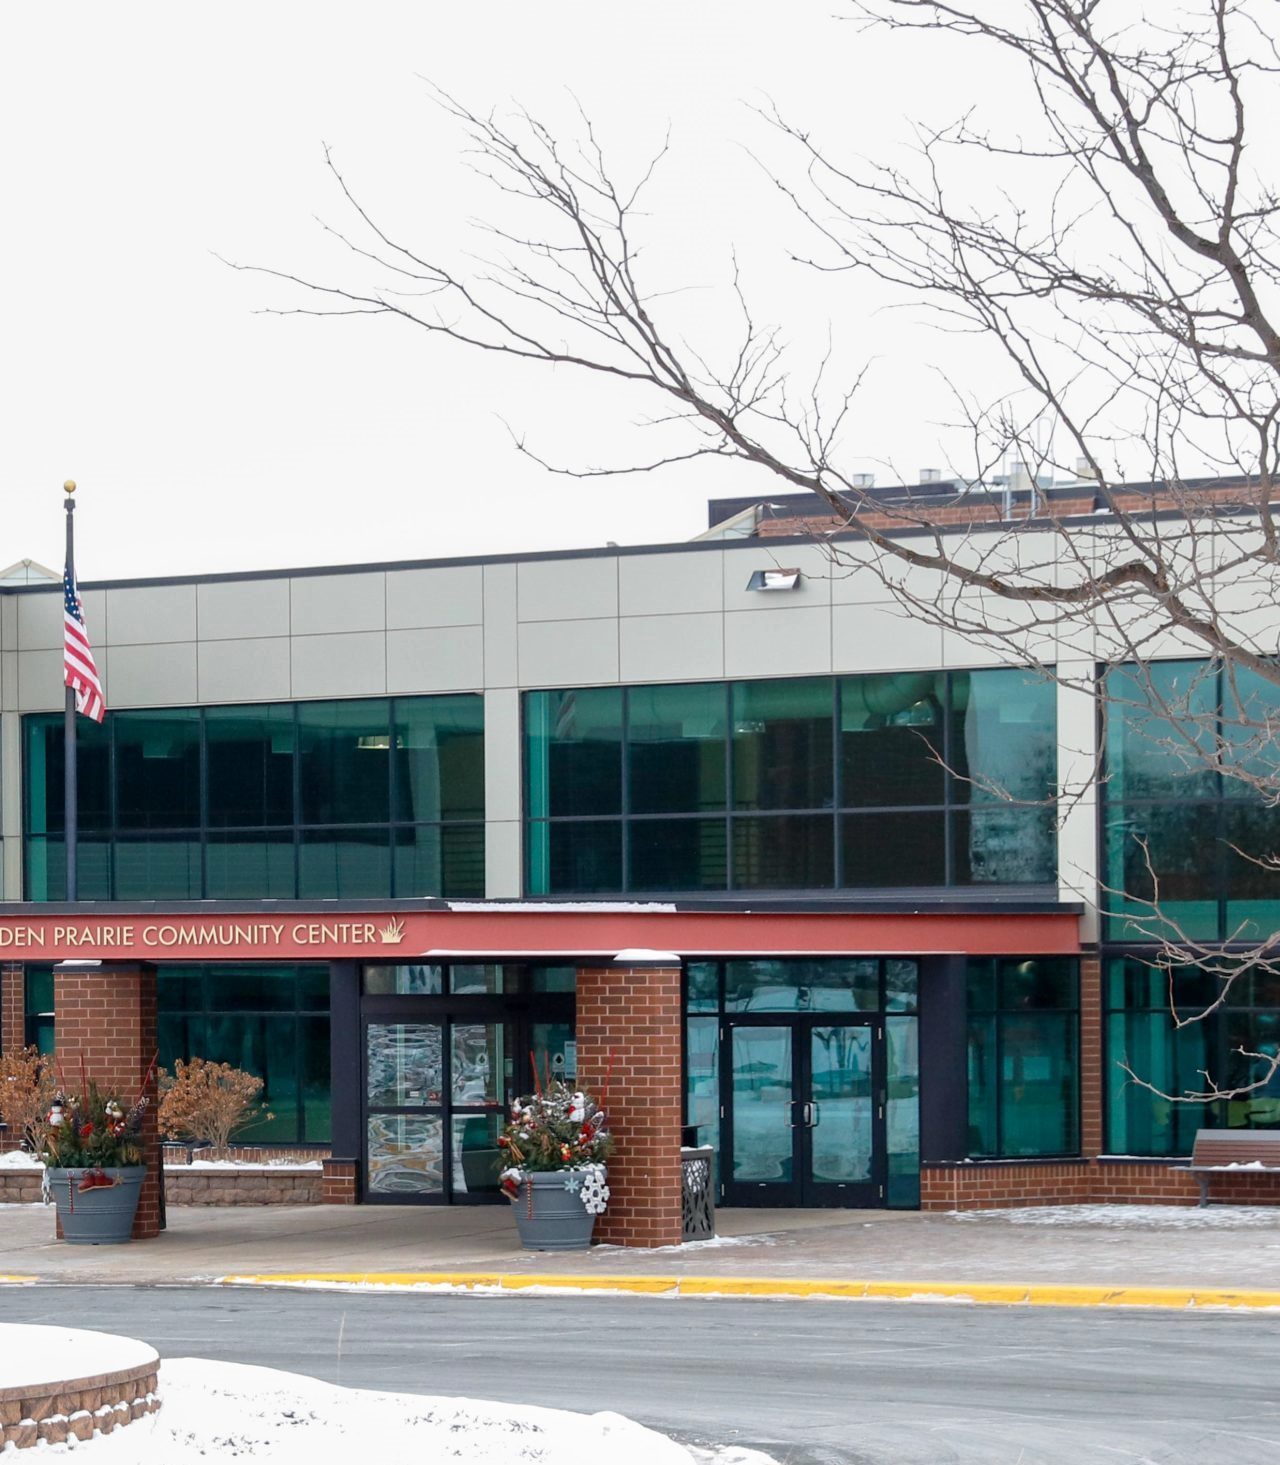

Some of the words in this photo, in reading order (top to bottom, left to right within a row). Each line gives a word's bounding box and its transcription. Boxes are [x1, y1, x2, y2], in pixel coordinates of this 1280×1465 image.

[54, 926, 134, 946] PRAIRIE
[142, 924, 285, 946] COMMUNITY
[292, 923, 377, 944] CENTER
